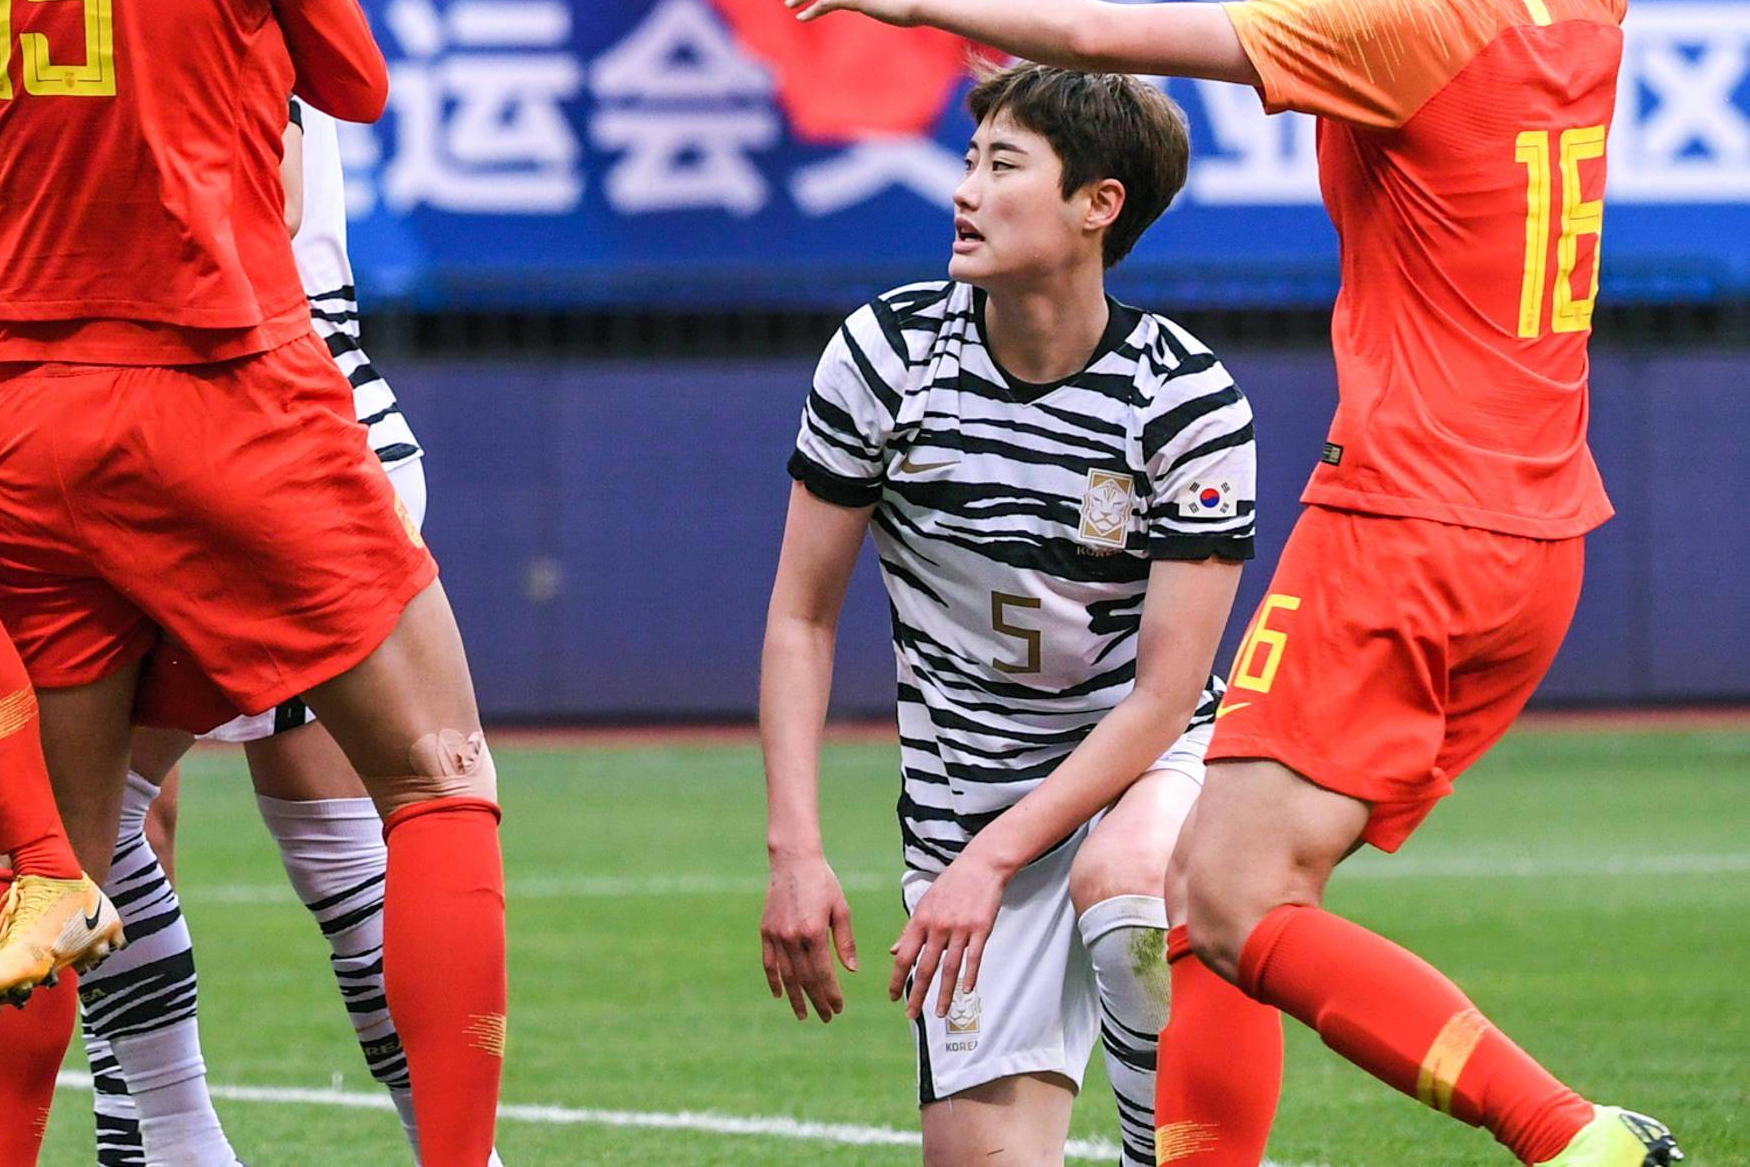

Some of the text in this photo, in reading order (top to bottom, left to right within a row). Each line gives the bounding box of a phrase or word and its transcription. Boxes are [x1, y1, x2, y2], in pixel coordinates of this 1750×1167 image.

[1515, 126, 1606, 338] 16
[991, 591, 1041, 674] 5
[1228, 593, 1302, 693] 6
